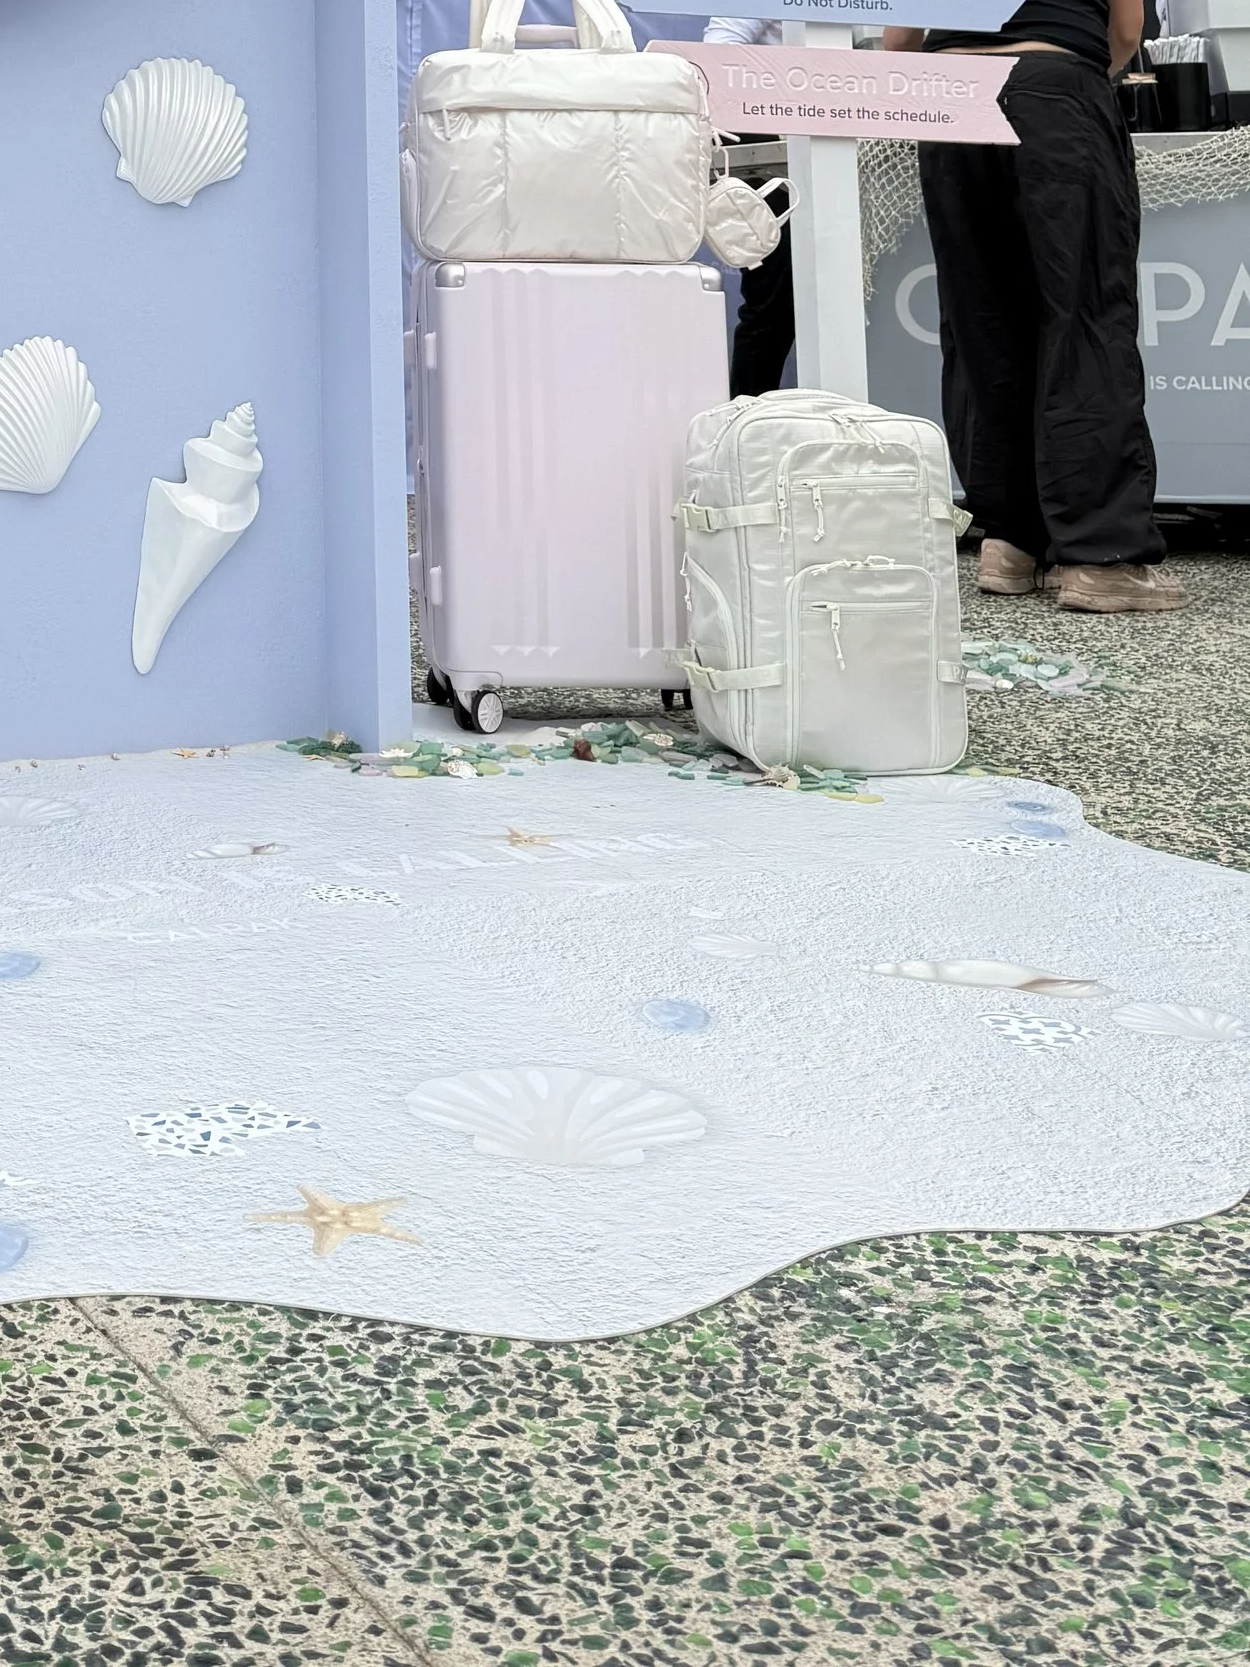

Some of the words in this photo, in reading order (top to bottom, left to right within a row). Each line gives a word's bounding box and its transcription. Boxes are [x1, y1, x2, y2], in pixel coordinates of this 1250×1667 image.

[722, 62, 776, 90] The
[785, 66, 878, 95] Ocean
[888, 70, 980, 100] Drifter
[742, 102, 765, 116] Let
[769, 102, 793, 117] the
[797, 103, 826, 118] tide
[830, 105, 852, 120] set
[856, 105, 879, 120] the
[884, 107, 954, 125] schedule.
[1150, 375, 1167, 390] IS
